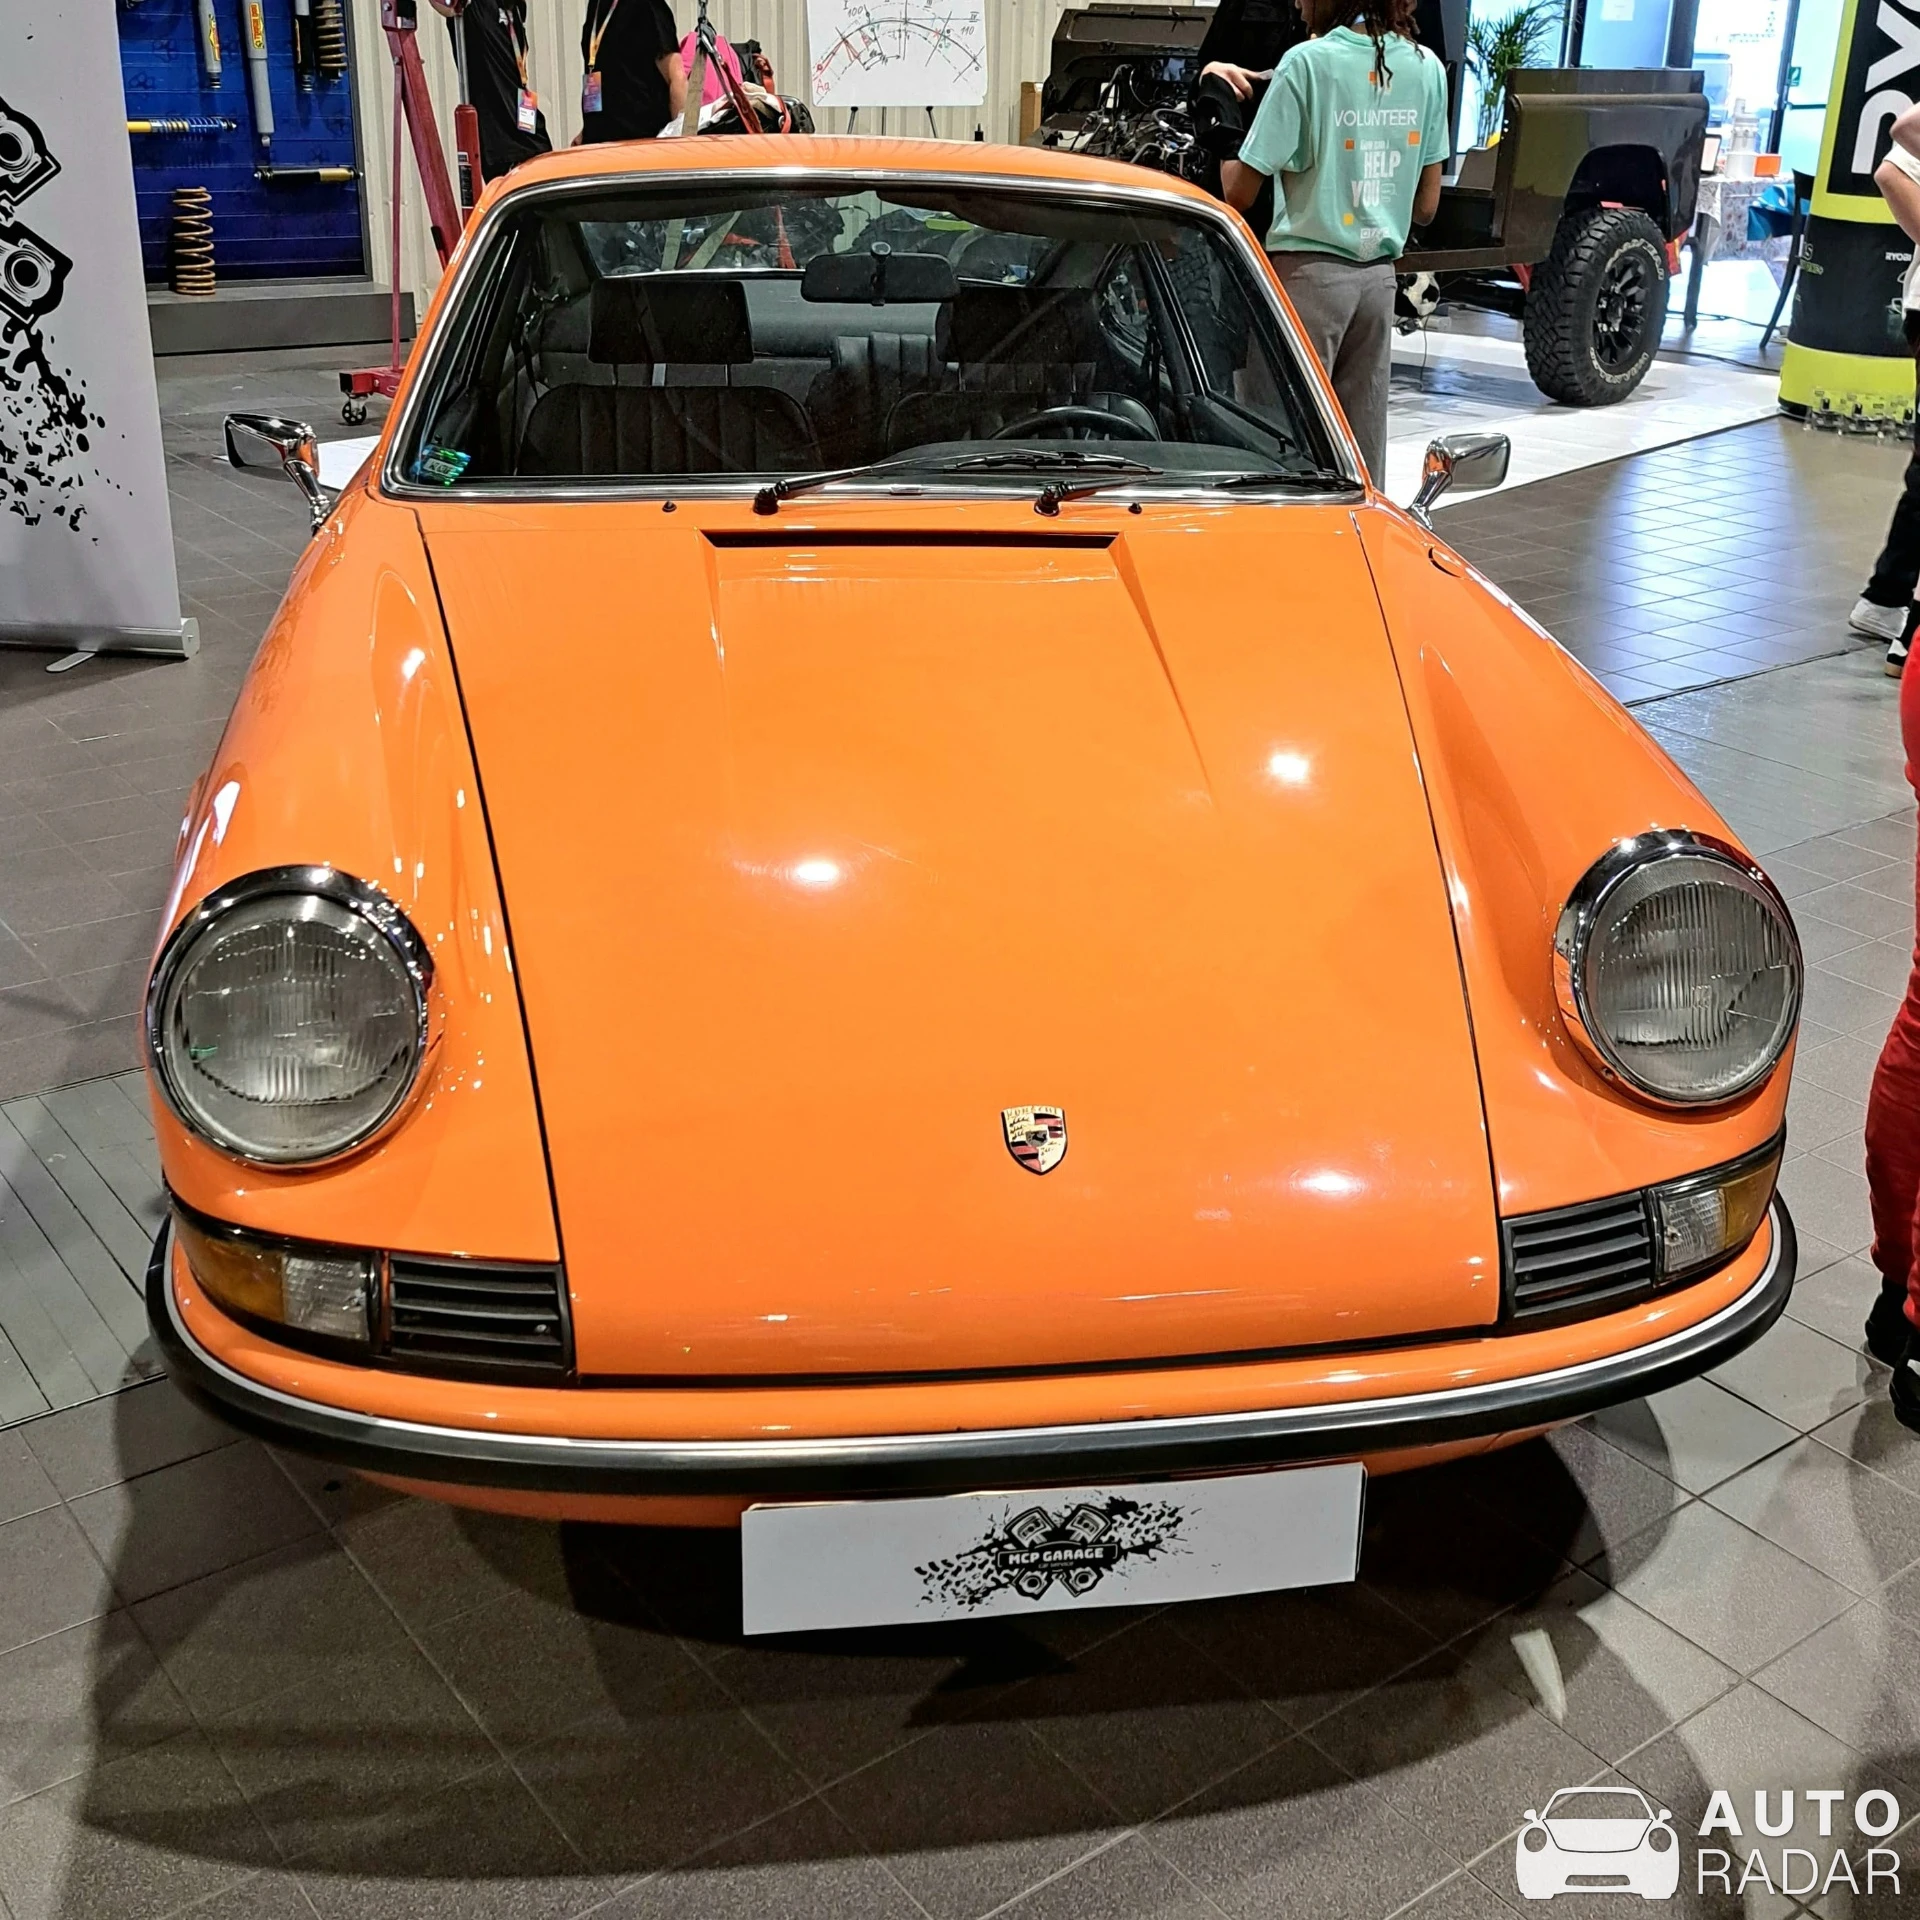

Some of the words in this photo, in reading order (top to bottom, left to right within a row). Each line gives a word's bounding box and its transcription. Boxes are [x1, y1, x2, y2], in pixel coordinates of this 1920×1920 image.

[848, 6, 863, 18] 100
[1333, 109, 1418, 127] VOLUNTEER
[1364, 151, 1401, 179] HELP
[1351, 180, 1380, 208] YOU
[1885, 251, 1912, 262] RYOBI
[1008, 1552, 1040, 1565] MCP
[1042, 1548, 1104, 1562] GARAGE
